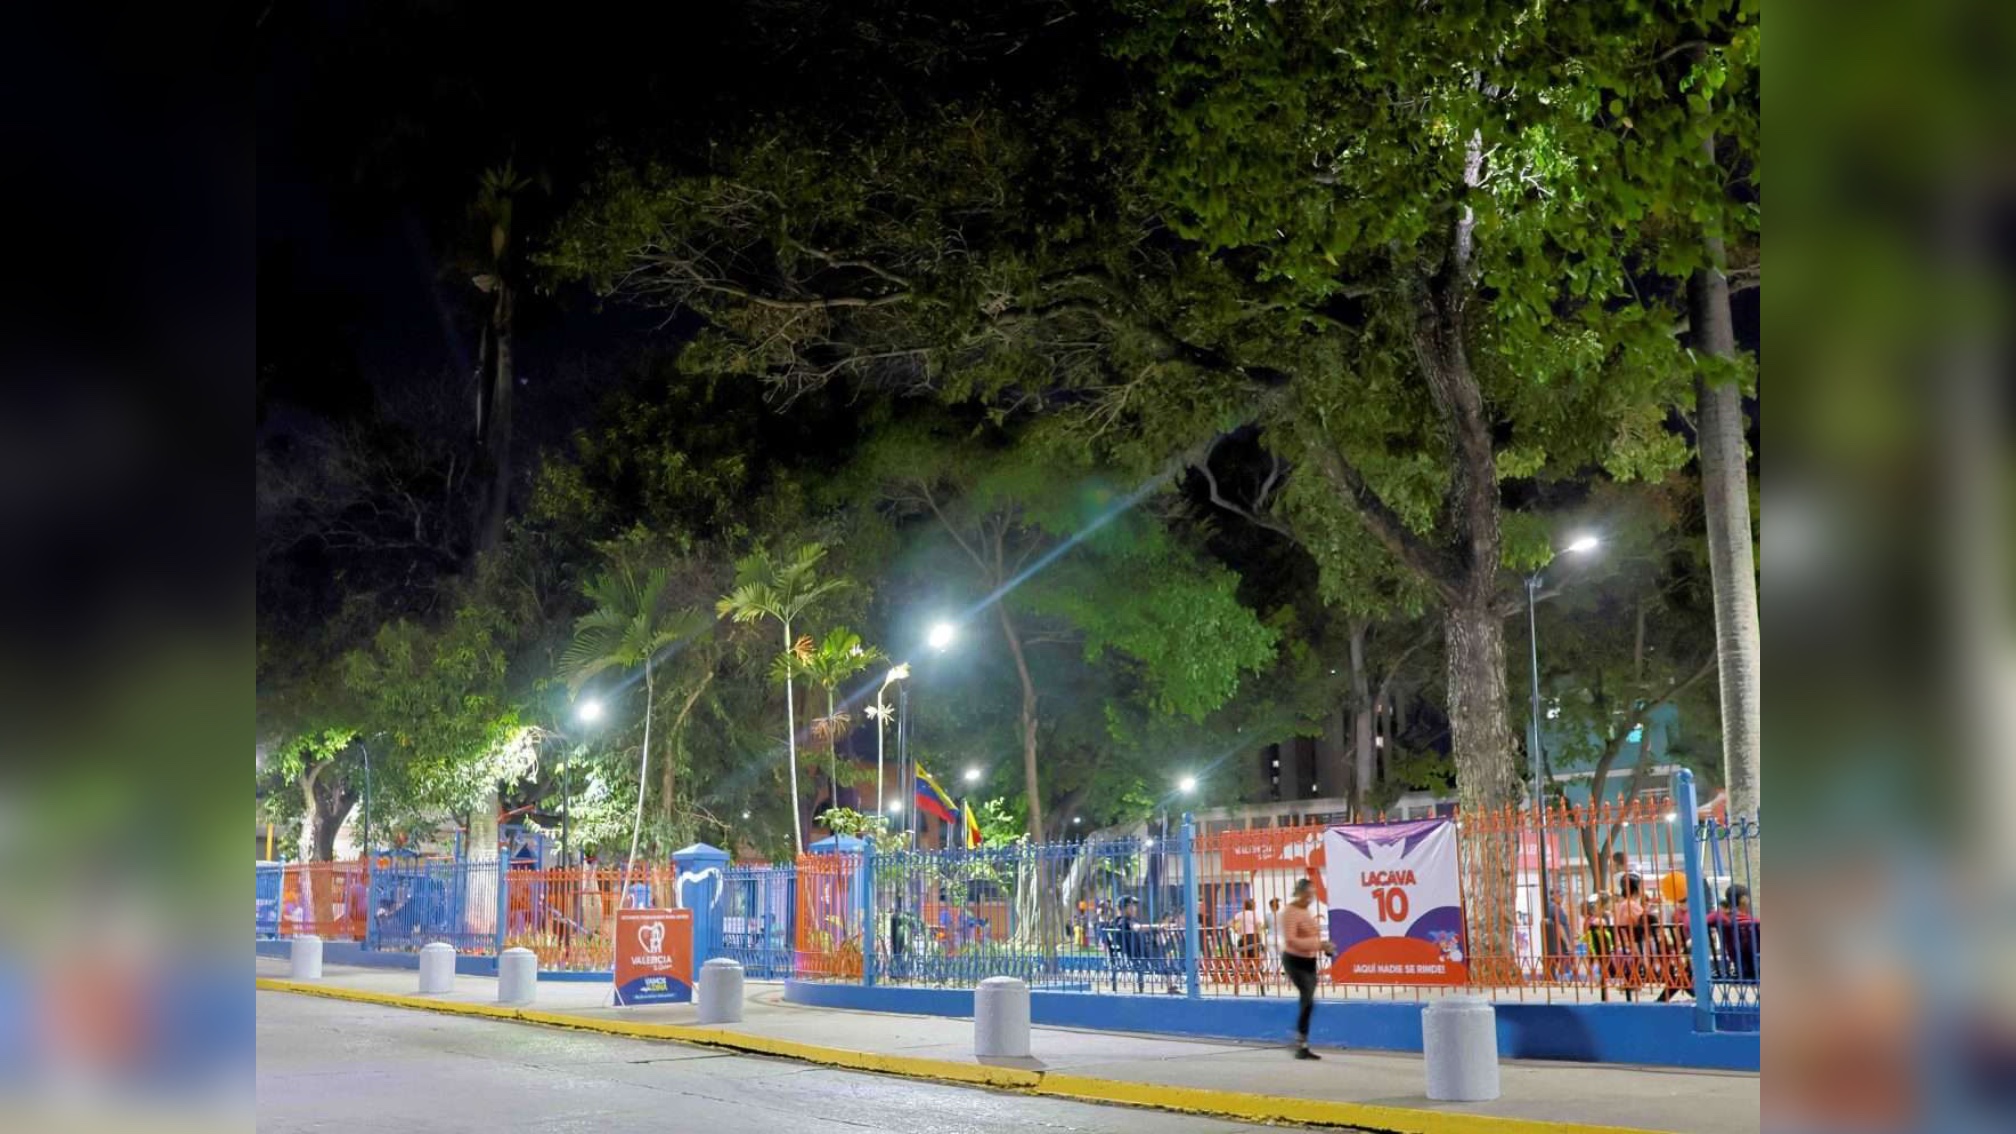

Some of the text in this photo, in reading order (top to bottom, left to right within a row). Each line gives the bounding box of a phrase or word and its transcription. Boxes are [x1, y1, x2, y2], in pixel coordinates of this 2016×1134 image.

[1361, 870, 1416, 887] LACAVA
[1371, 887, 1409, 922] 10
[1377, 964, 1403, 974] NADIE
[1404, 964, 1416, 974] SE
[1416, 964, 1446, 975] RINDE!
